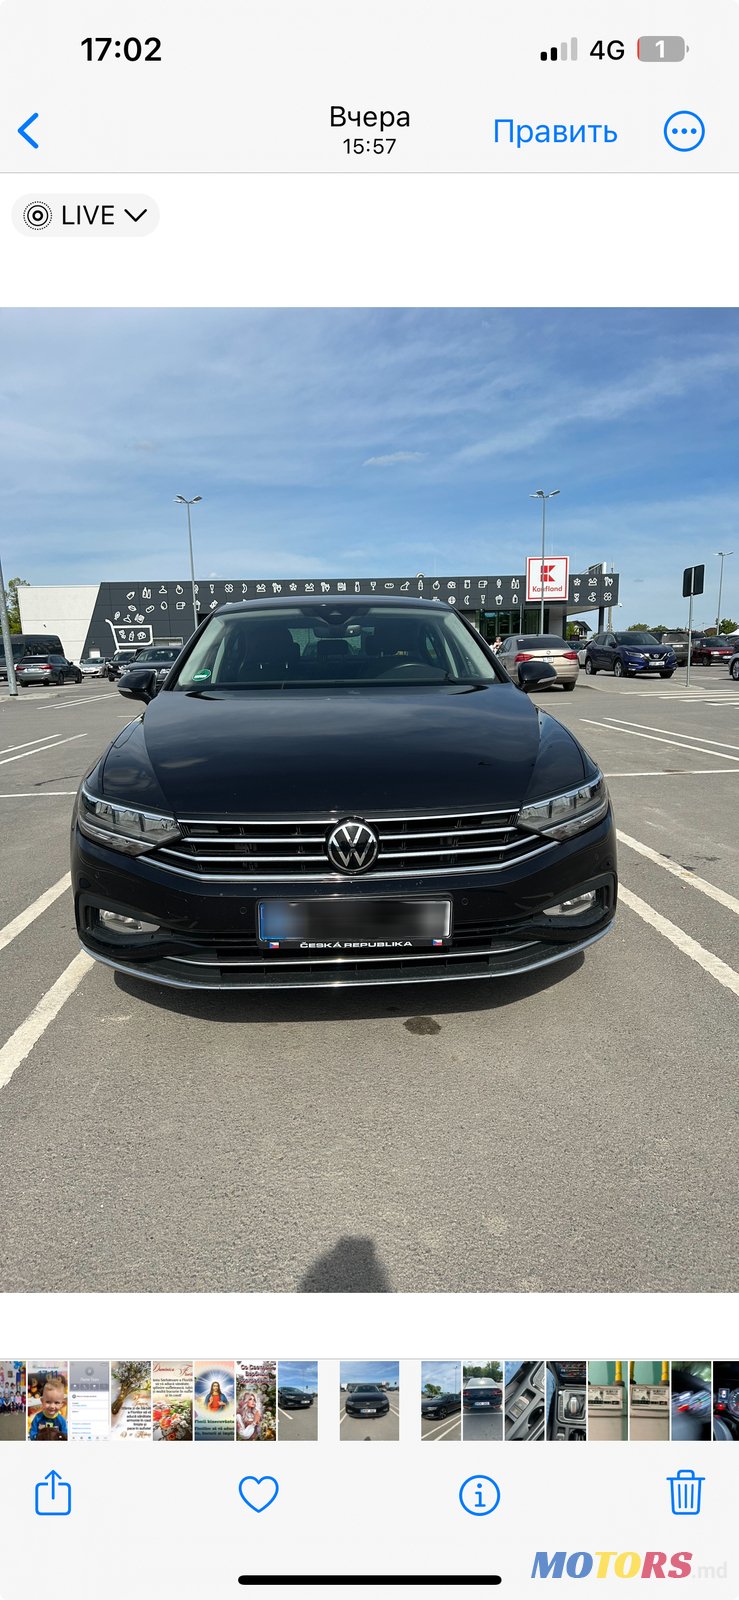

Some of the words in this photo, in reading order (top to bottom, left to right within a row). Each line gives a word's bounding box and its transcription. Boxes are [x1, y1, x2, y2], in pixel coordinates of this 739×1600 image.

[80, 36, 162, 62] 17:02
[589, 39, 625, 61] 4G
[654, 39, 665, 59] 1
[330, 105, 410, 132] Вчера
[494, 118, 618, 148] Править
[342, 138, 397, 155] 15:57
[62, 204, 115, 226] LIVE
[300, 941, 344, 949] ČESKÁ
